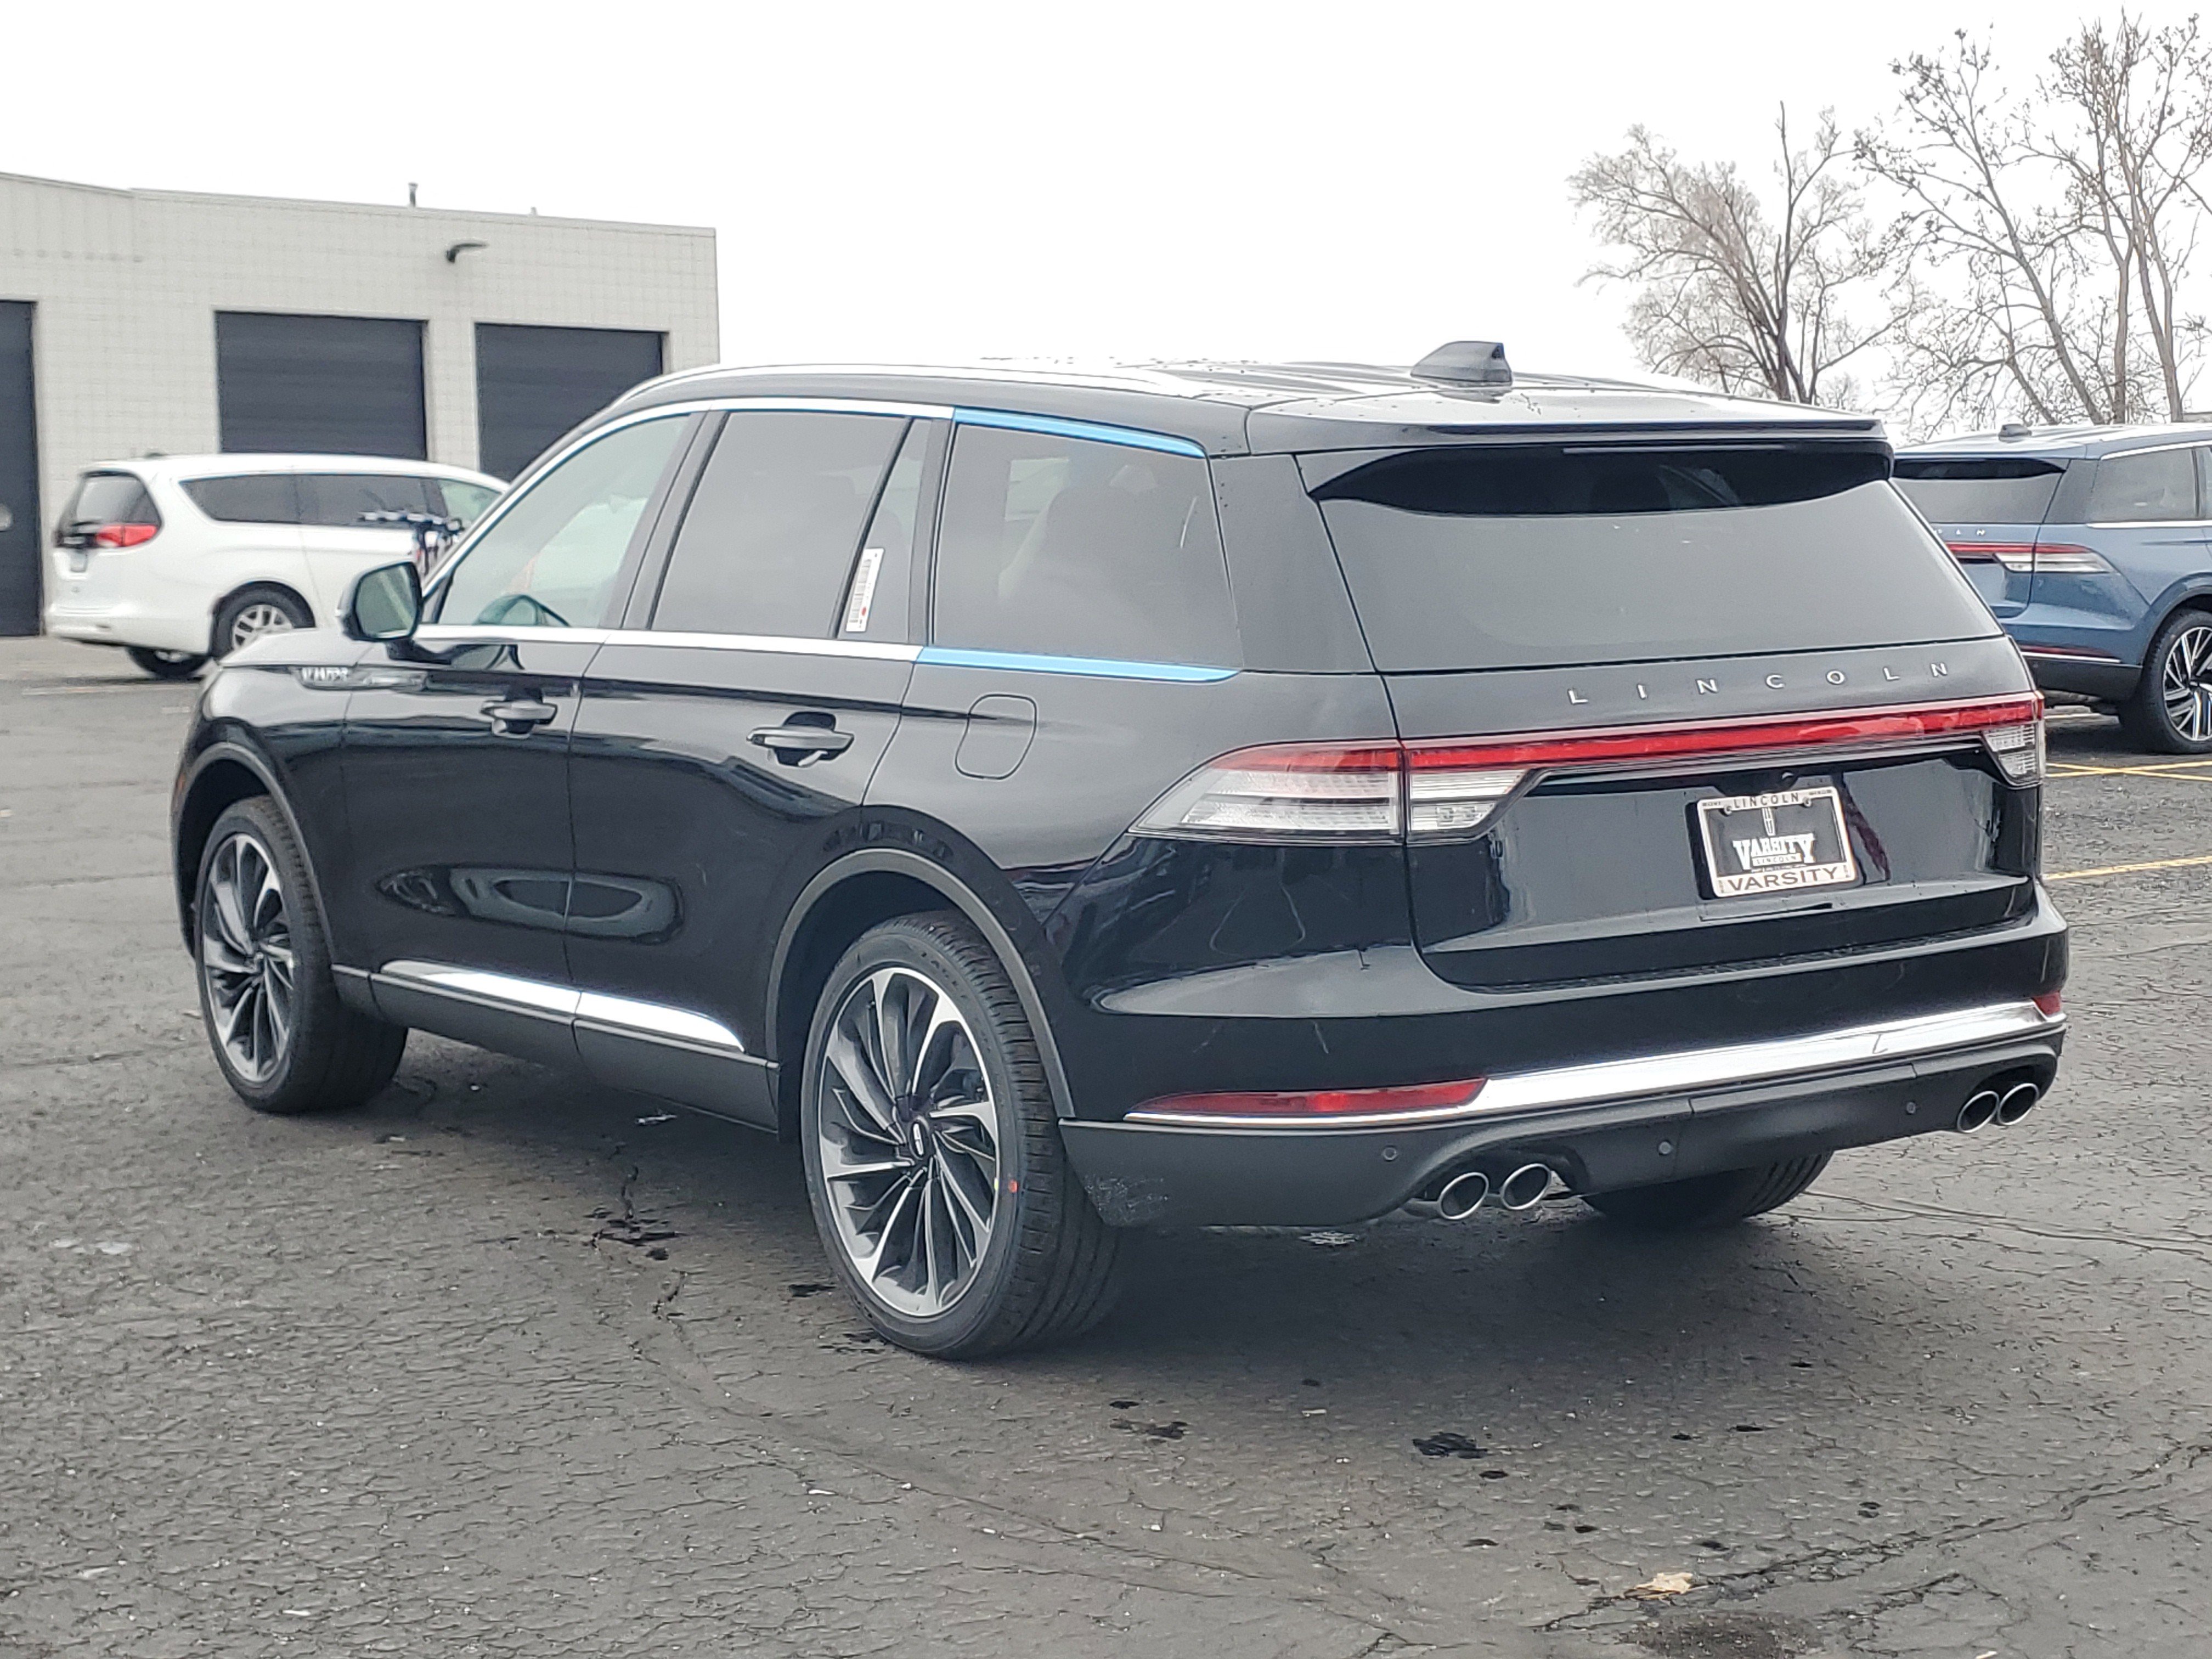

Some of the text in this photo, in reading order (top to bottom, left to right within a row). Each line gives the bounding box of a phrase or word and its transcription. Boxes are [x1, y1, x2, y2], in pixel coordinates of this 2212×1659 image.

[1567, 662, 1948, 705] LINCOLN
[1733, 792, 1799, 809] LINCOLN
[1732, 832, 1816, 871] VARSITY
[1756, 855, 1797, 865] LINCOLN
[1728, 866, 1838, 891] VARSITY
